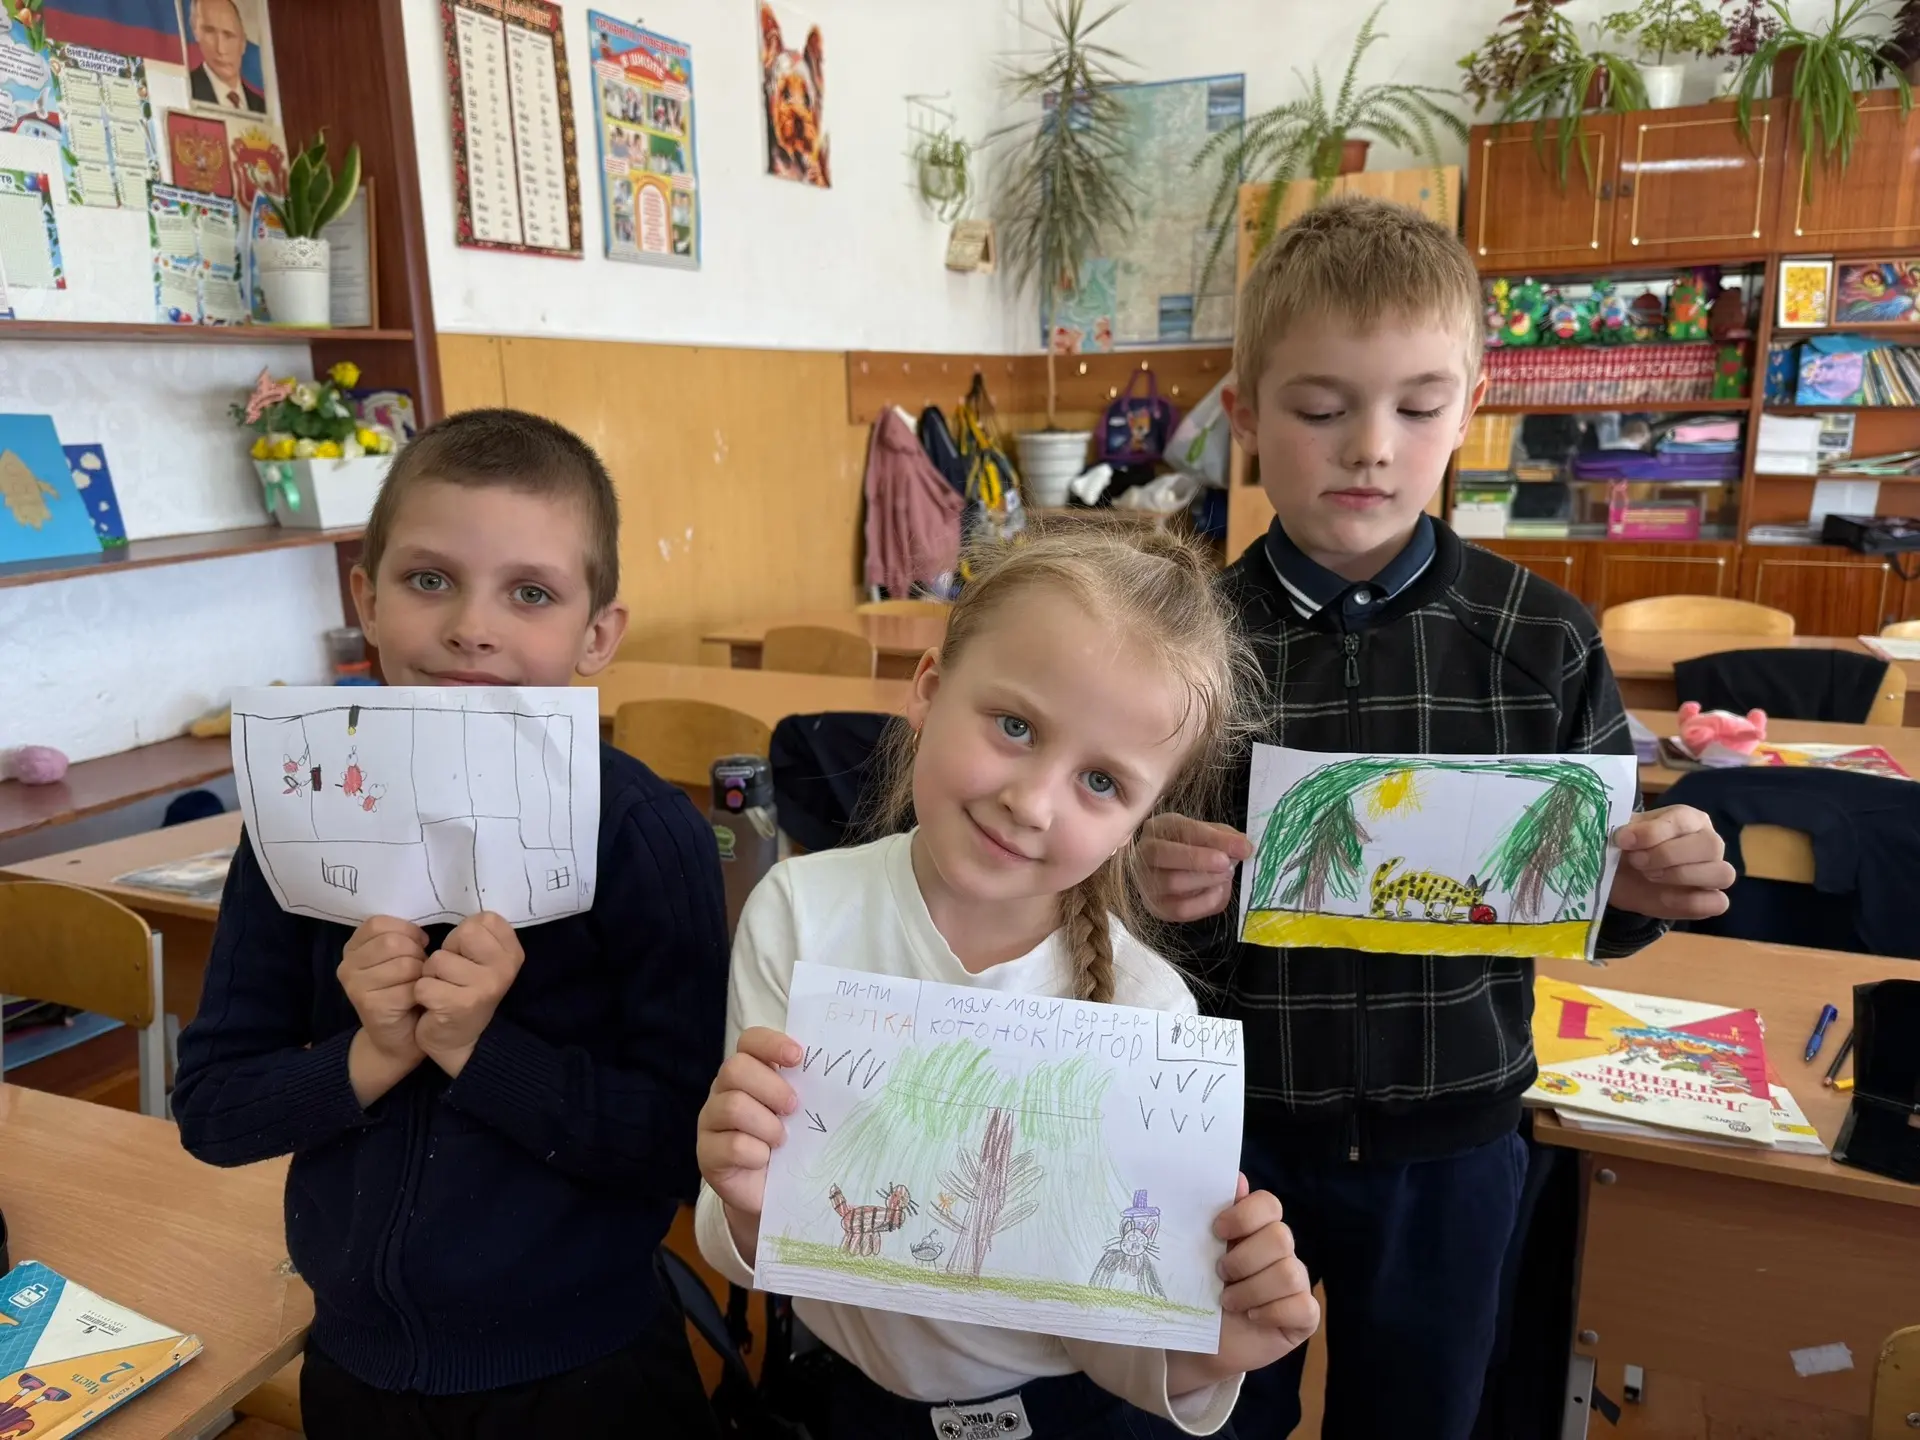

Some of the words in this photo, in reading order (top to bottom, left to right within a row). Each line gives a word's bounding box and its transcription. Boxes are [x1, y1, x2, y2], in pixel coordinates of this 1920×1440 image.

[66, 47, 126, 66] ВНЕКЛАССНЫЕ
[79, 60, 118, 74] ЗАНЯТИЯ
[1599, 1063, 1719, 1095] ЧТЕНИЕ
[1572, 1070, 1748, 1113] Литературное
[100, 1362, 135, 1384] 2
[72, 1374, 101, 1395] Часть
